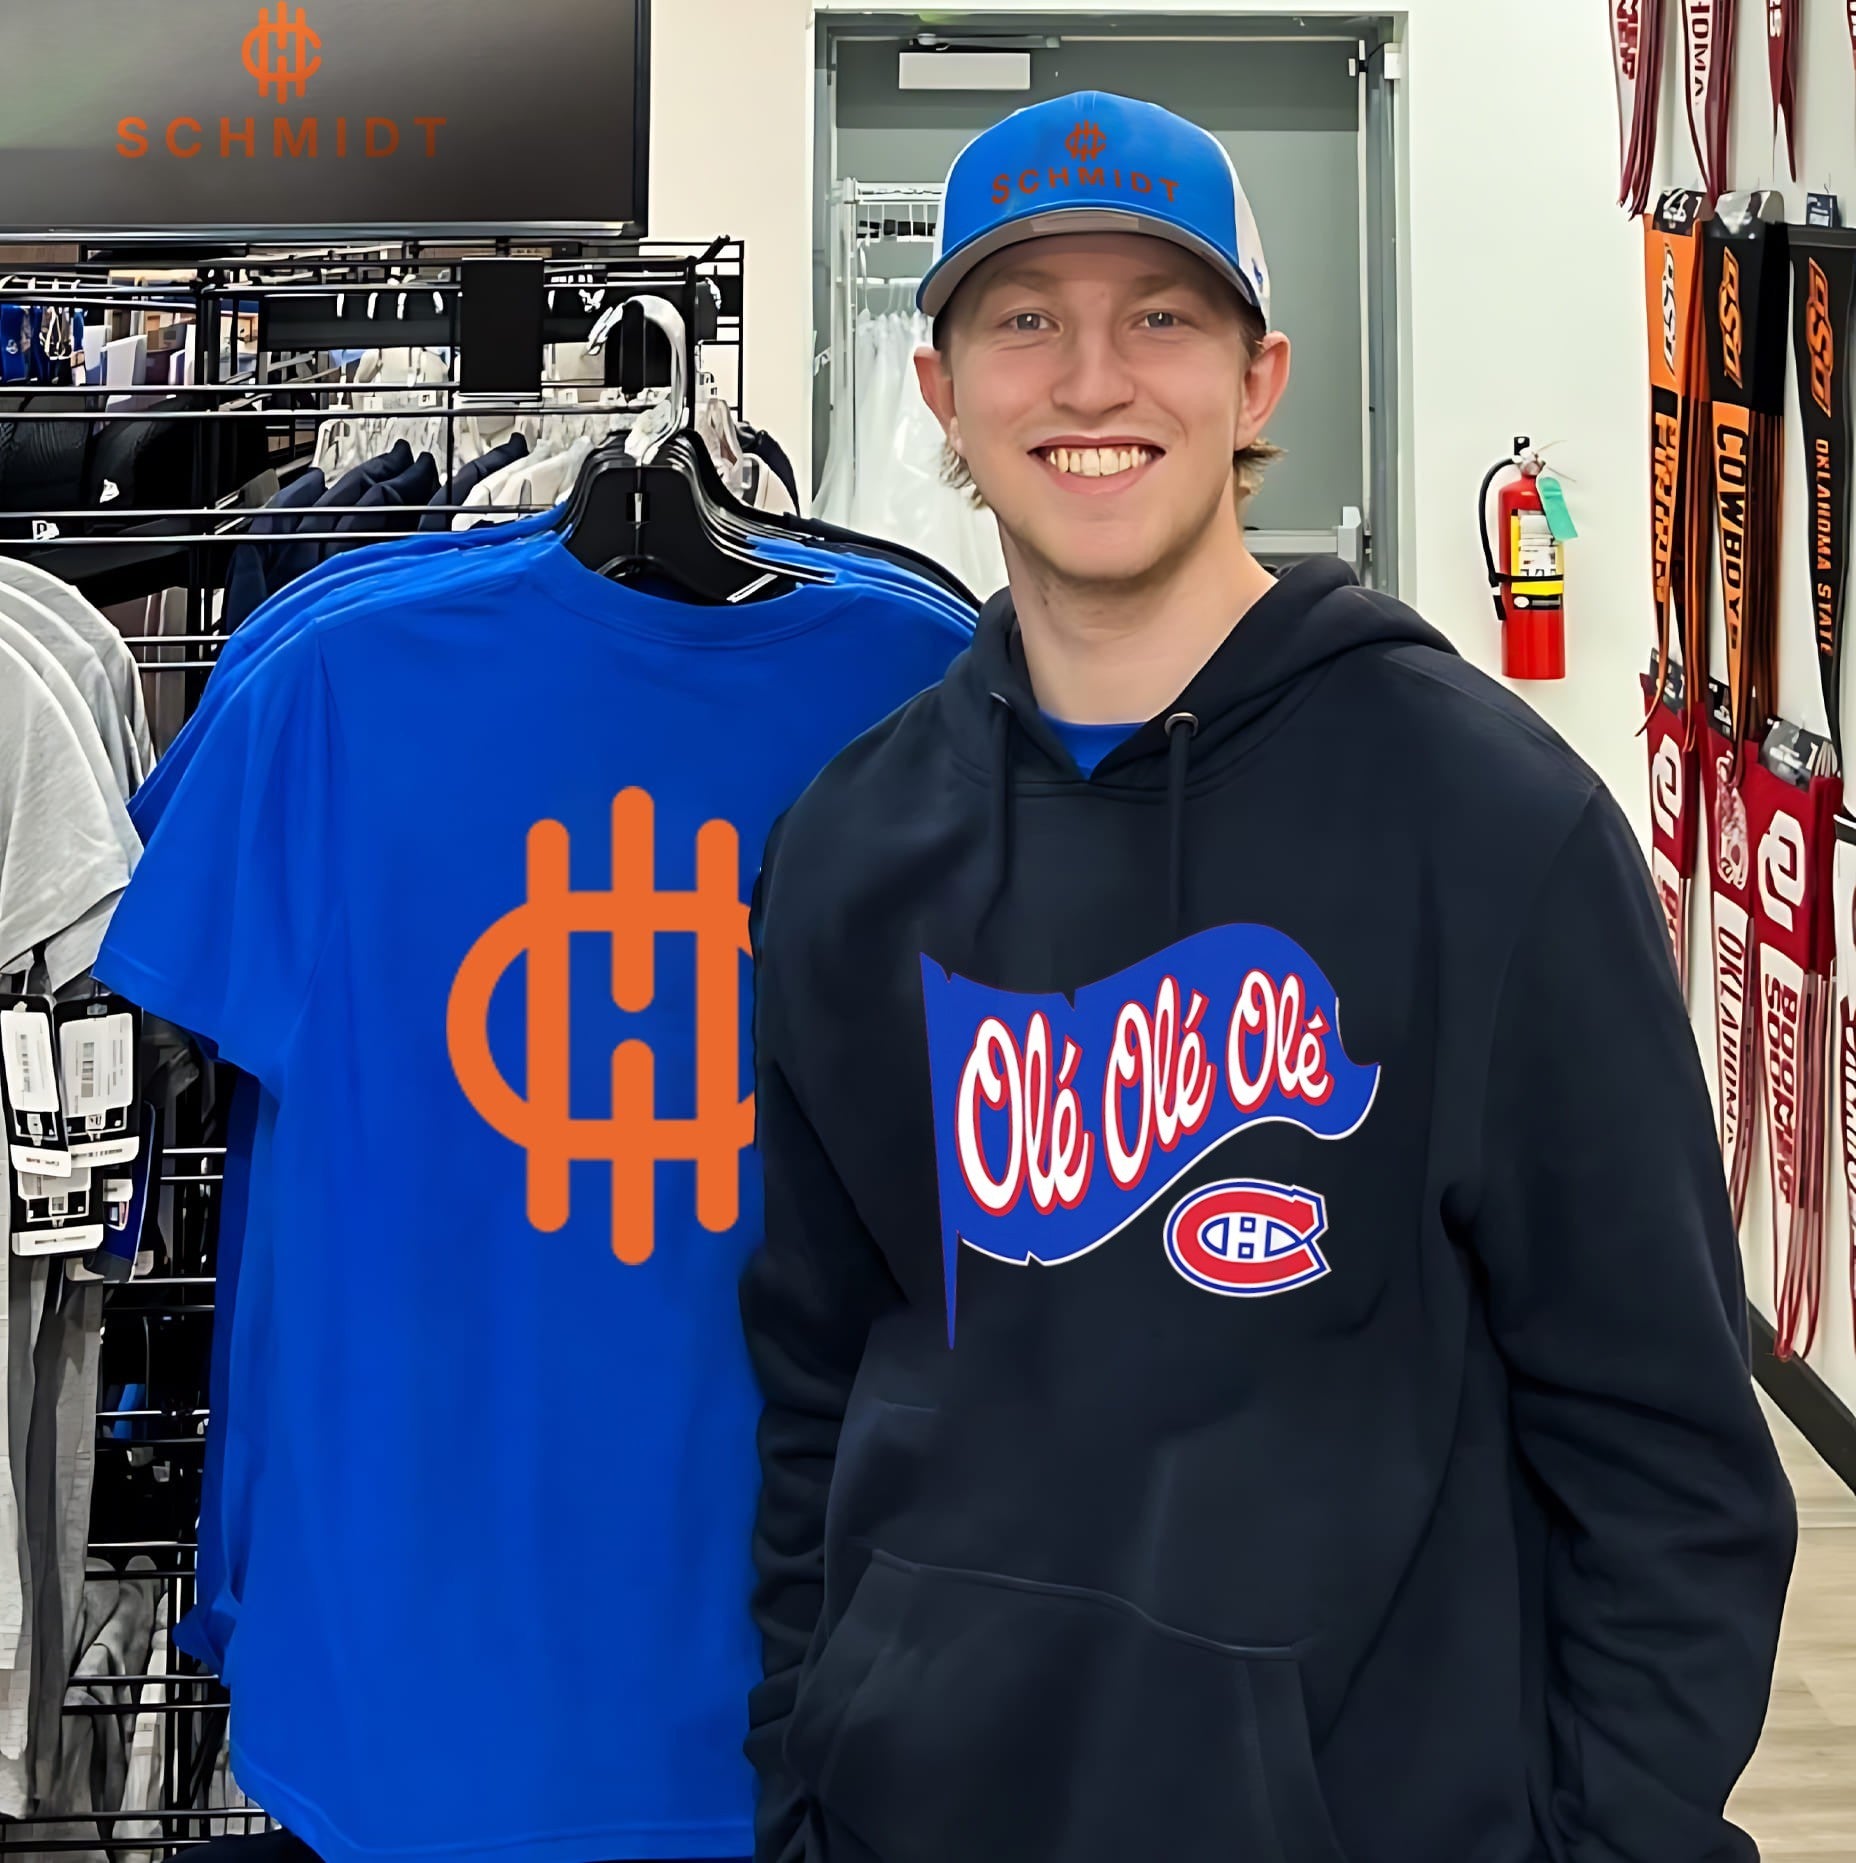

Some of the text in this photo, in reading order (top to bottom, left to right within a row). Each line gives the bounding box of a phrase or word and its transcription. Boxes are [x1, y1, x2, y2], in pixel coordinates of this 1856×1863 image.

[116, 116, 447, 159] SCHMIDT
[991, 166, 1179, 205] SCHMIDT
[1815, 438, 1832, 570] OKLAHOMA
[956, 969, 1334, 1215] Olé Olé Olé
[1717, 925, 1746, 1144] OKLAHOMA
